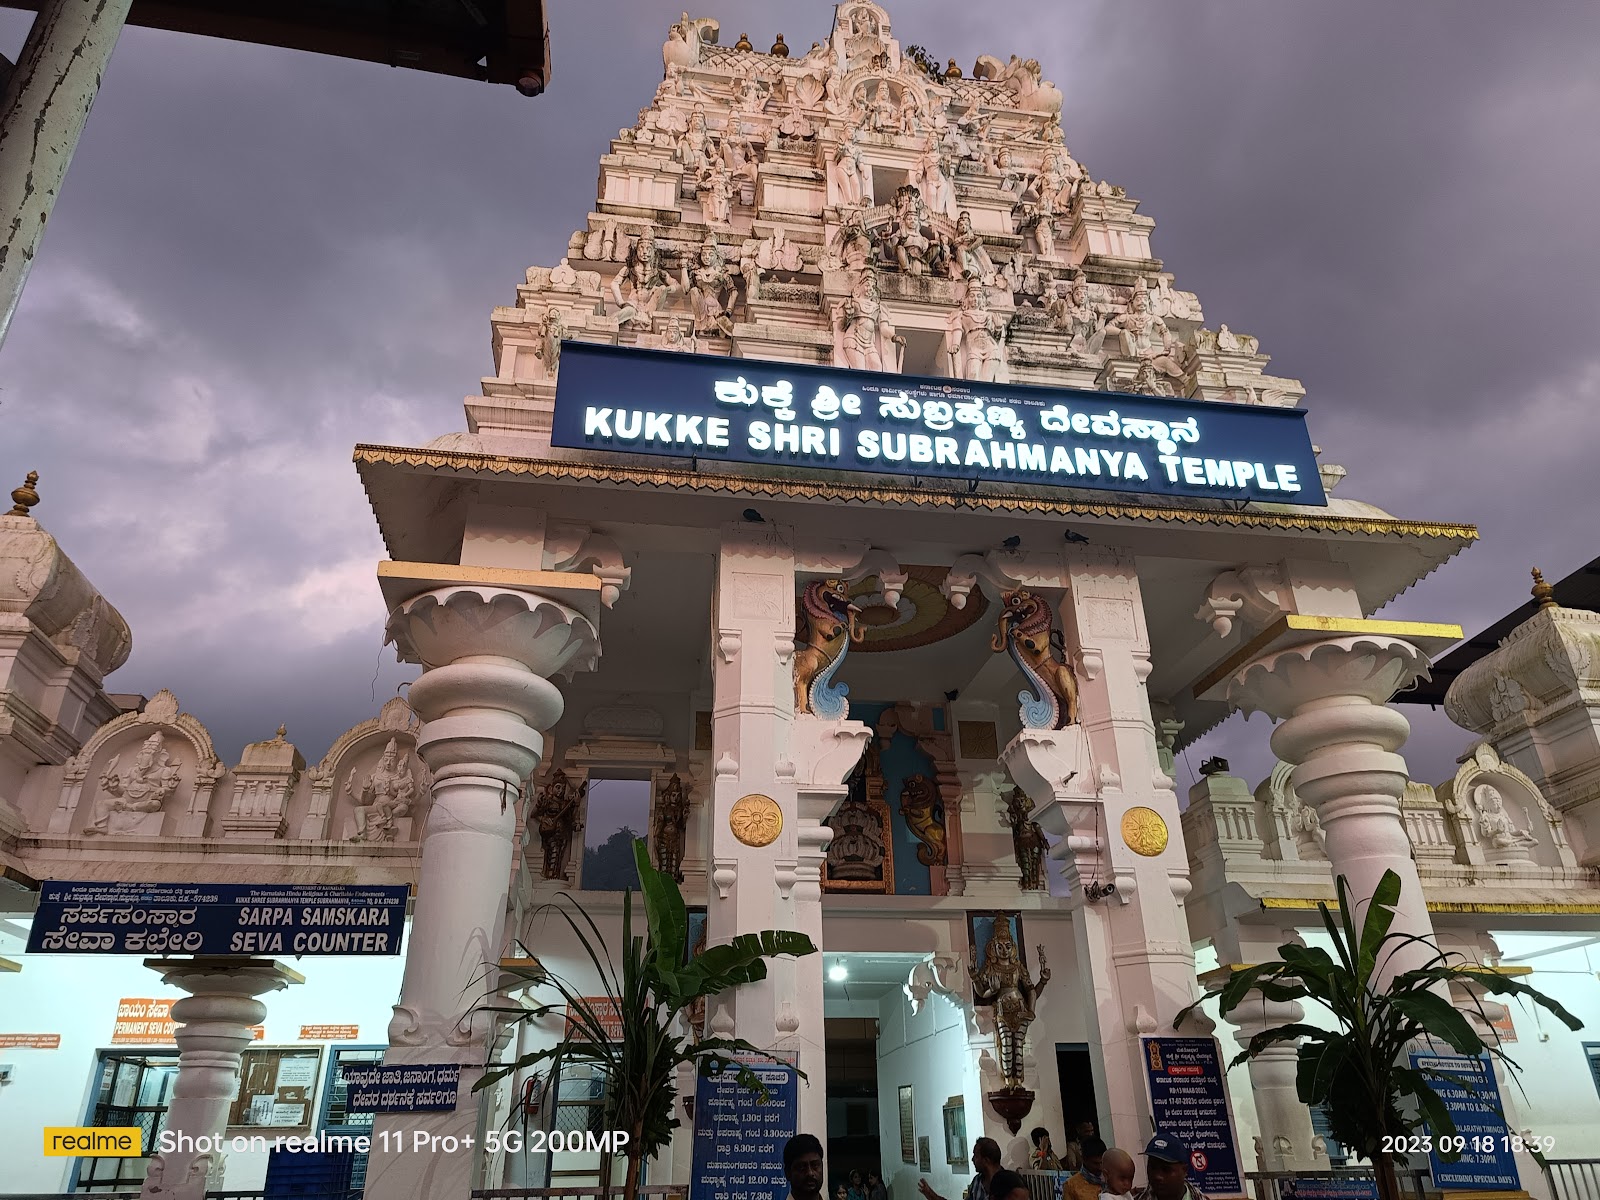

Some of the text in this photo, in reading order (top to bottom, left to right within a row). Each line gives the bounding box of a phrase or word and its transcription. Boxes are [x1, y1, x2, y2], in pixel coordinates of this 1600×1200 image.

[713, 376, 1200, 456] ಕುಕ್ಕೆ ಶ್ರೀ ಸುಬ್ರಹ್ಮಣ್ಯ ದೇವಸ್ಥಾನ
[584, 406, 1302, 493] KUKKE SHRI SUBRAHMANYA TEMPLE
[238, 907, 390, 927] SARPA SAMSKARA
[42, 925, 204, 953] ಸೇವಾ ಕಛೇರಿ
[229, 931, 388, 952] SEVA COUNTER
[147, 1000, 169, 1018] ಸೇವಾ
[115, 1022, 163, 1035] PERMANENT SEVA
[344, 1067, 381, 1088] ಯಾವುದೇ
[353, 1089, 379, 1107] ದೇವರ
[381, 1088, 416, 1110] ದರ್ಶನಕ್ಕೆ
[747, 1176, 768, 1184] 12.00
